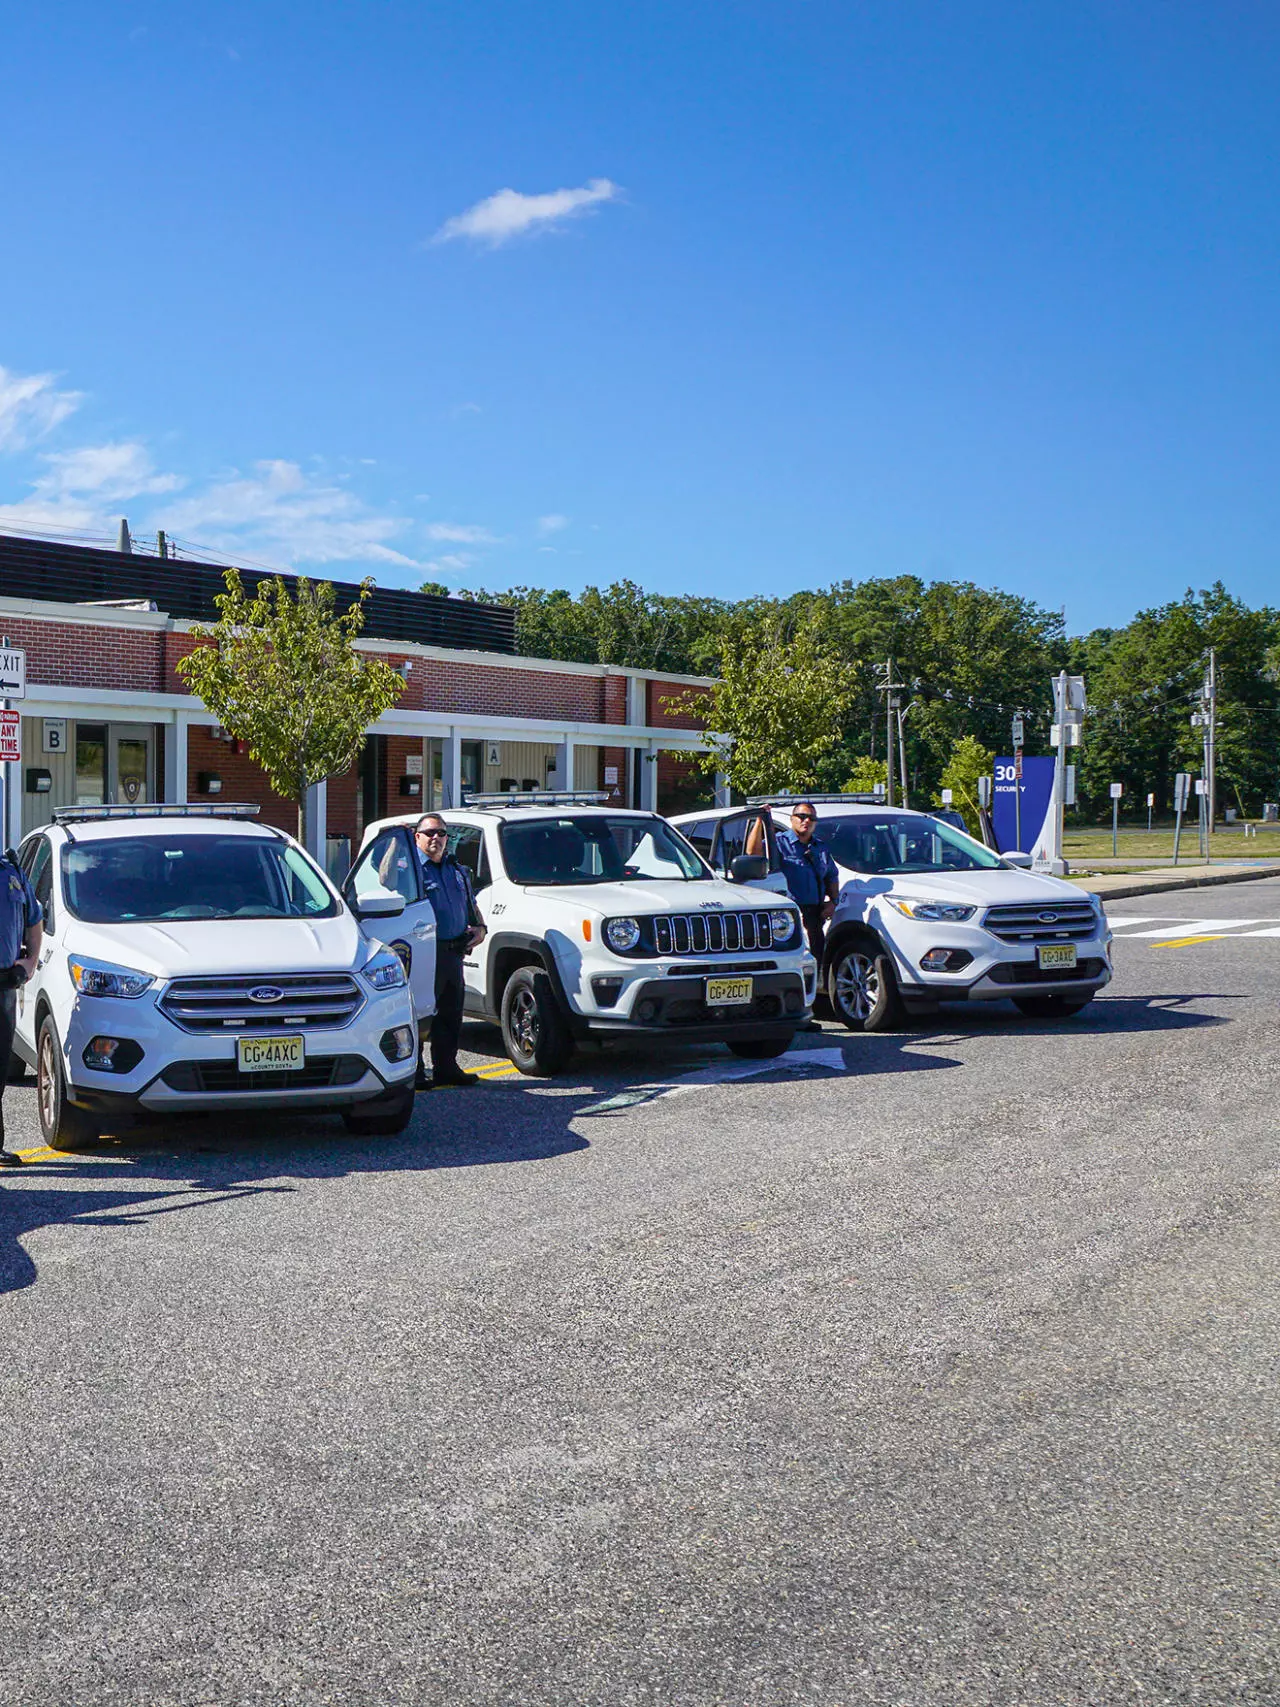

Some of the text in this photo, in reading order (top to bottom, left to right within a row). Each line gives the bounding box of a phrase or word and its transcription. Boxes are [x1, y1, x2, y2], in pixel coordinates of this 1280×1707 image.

[1, 724, 17, 737] ANY
[0, 739, 18, 752] TIME
[49, 730, 60, 748] B
[490, 747, 498, 762] A
[994, 765, 1016, 781] 30
[491, 903, 507, 915] 221
